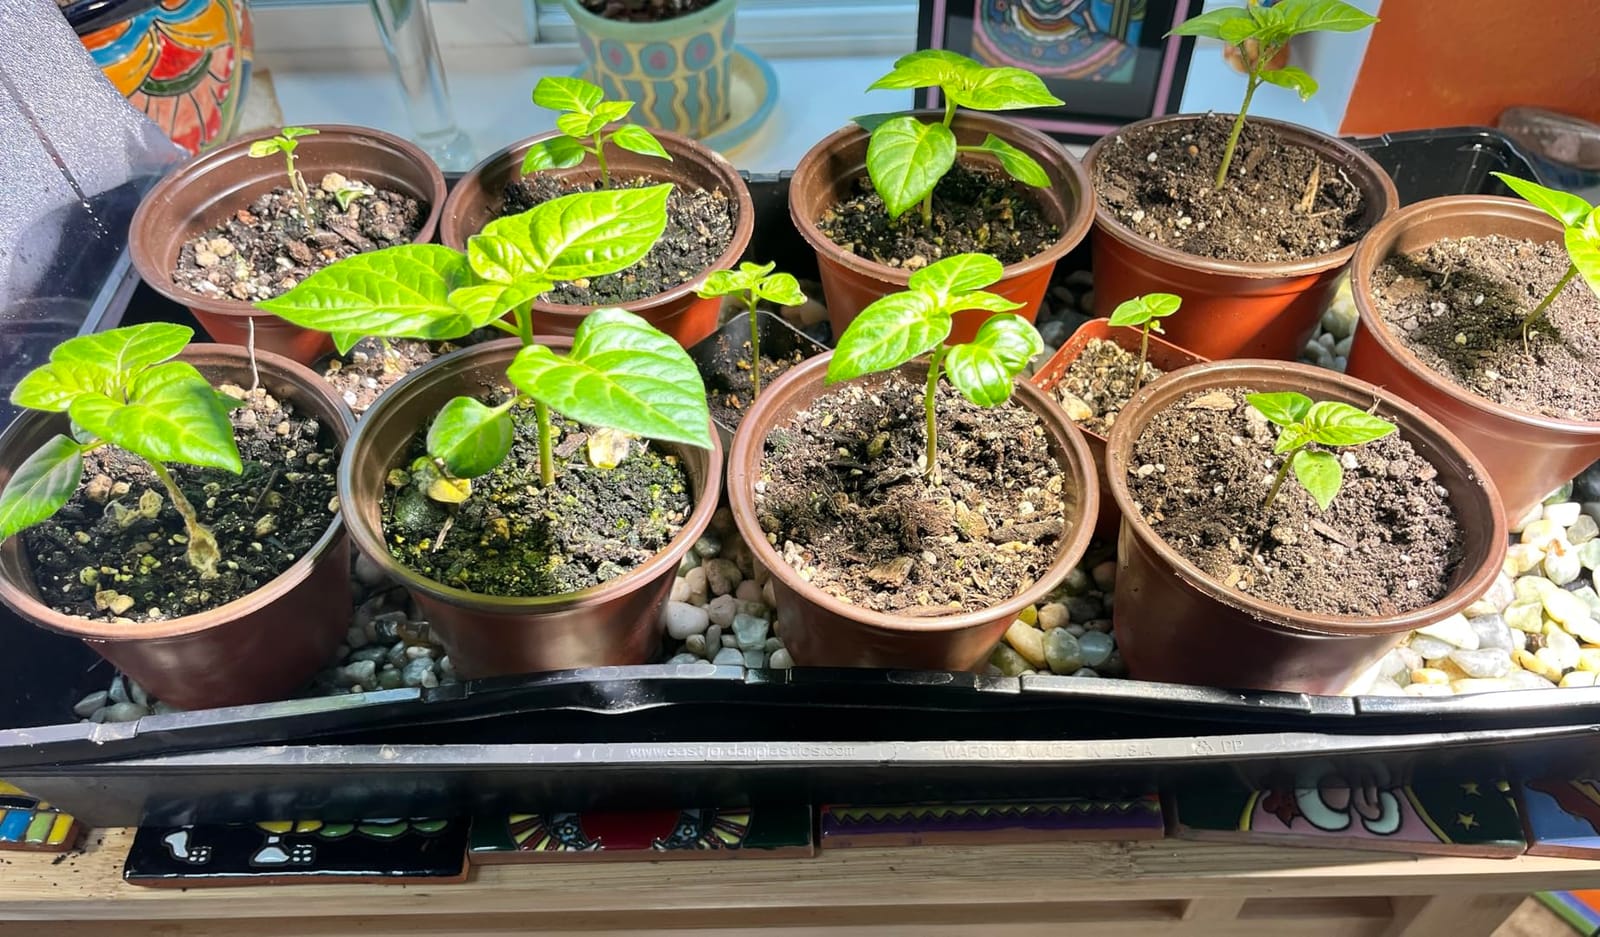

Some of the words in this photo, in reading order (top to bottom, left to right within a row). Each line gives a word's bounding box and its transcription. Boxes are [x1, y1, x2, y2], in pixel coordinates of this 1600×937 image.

[629, 743, 856, 758] www.eastjordanplastics.com
[1026, 743, 1073, 757] MADE
[1087, 743, 1104, 757] IN
[1220, 740, 1243, 753] PP
